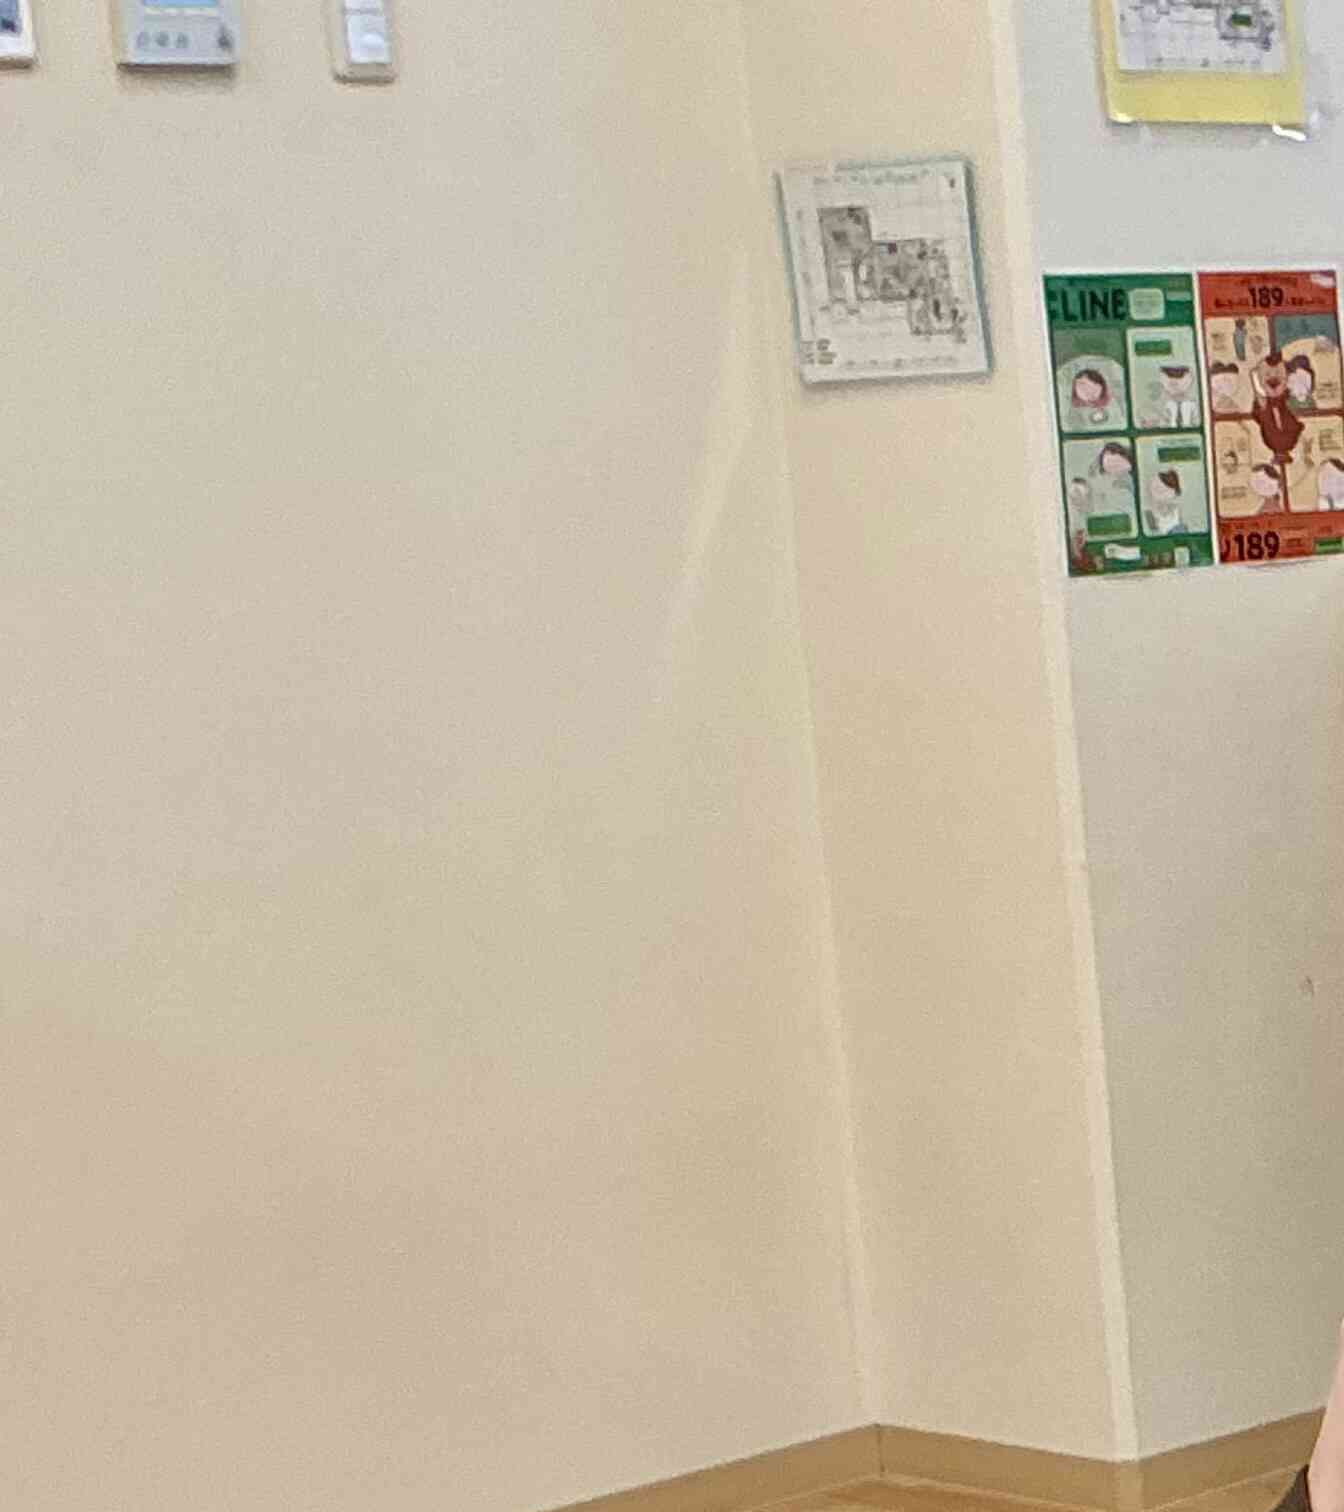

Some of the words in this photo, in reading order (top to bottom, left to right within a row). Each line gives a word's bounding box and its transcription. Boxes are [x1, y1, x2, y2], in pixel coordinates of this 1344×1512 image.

[1062, 288, 1126, 322] LINE
[1248, 285, 1284, 309] 189
[1234, 530, 1280, 561] 189
